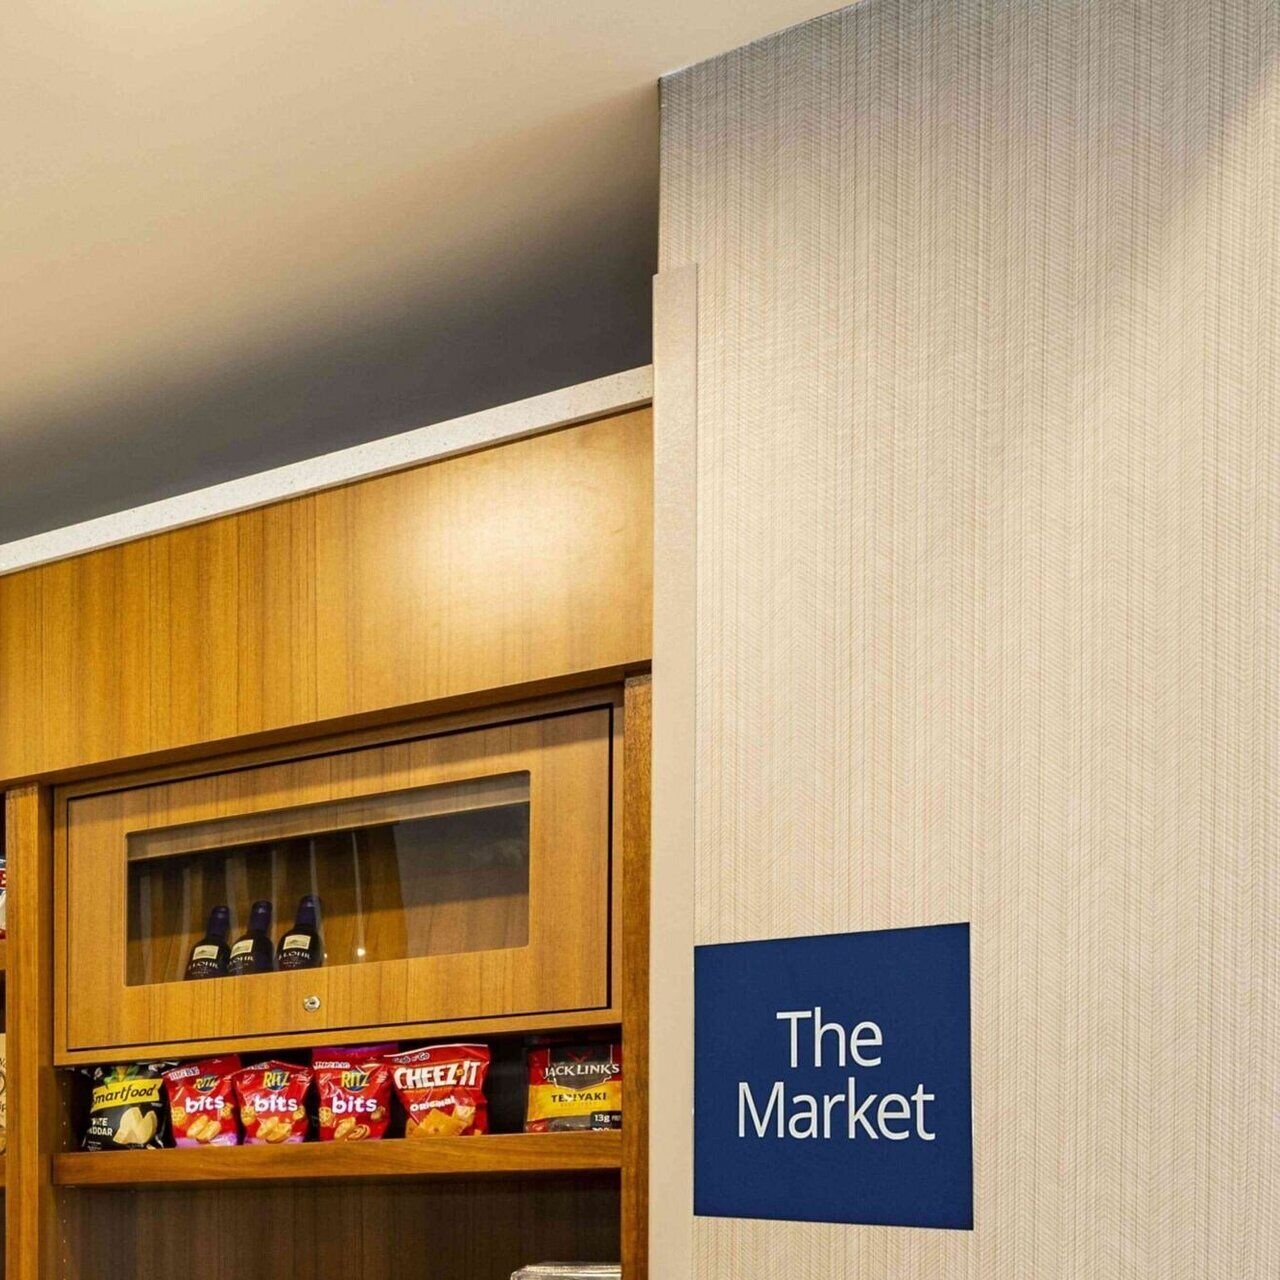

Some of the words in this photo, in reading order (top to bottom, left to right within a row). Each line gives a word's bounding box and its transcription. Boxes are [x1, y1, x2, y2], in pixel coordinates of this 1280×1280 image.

[776, 1007, 883, 1067] The
[263, 1071, 290, 1088] RITZ
[341, 1071, 370, 1088] RITZ
[543, 1066, 576, 1079] JACK
[93, 1085, 156, 1103] martfood
[185, 1096, 225, 1113] bits
[254, 1094, 298, 1112] bits
[332, 1096, 378, 1114] bits
[738, 1077, 936, 1140] Market
[595, 1114, 610, 1123] 13g
